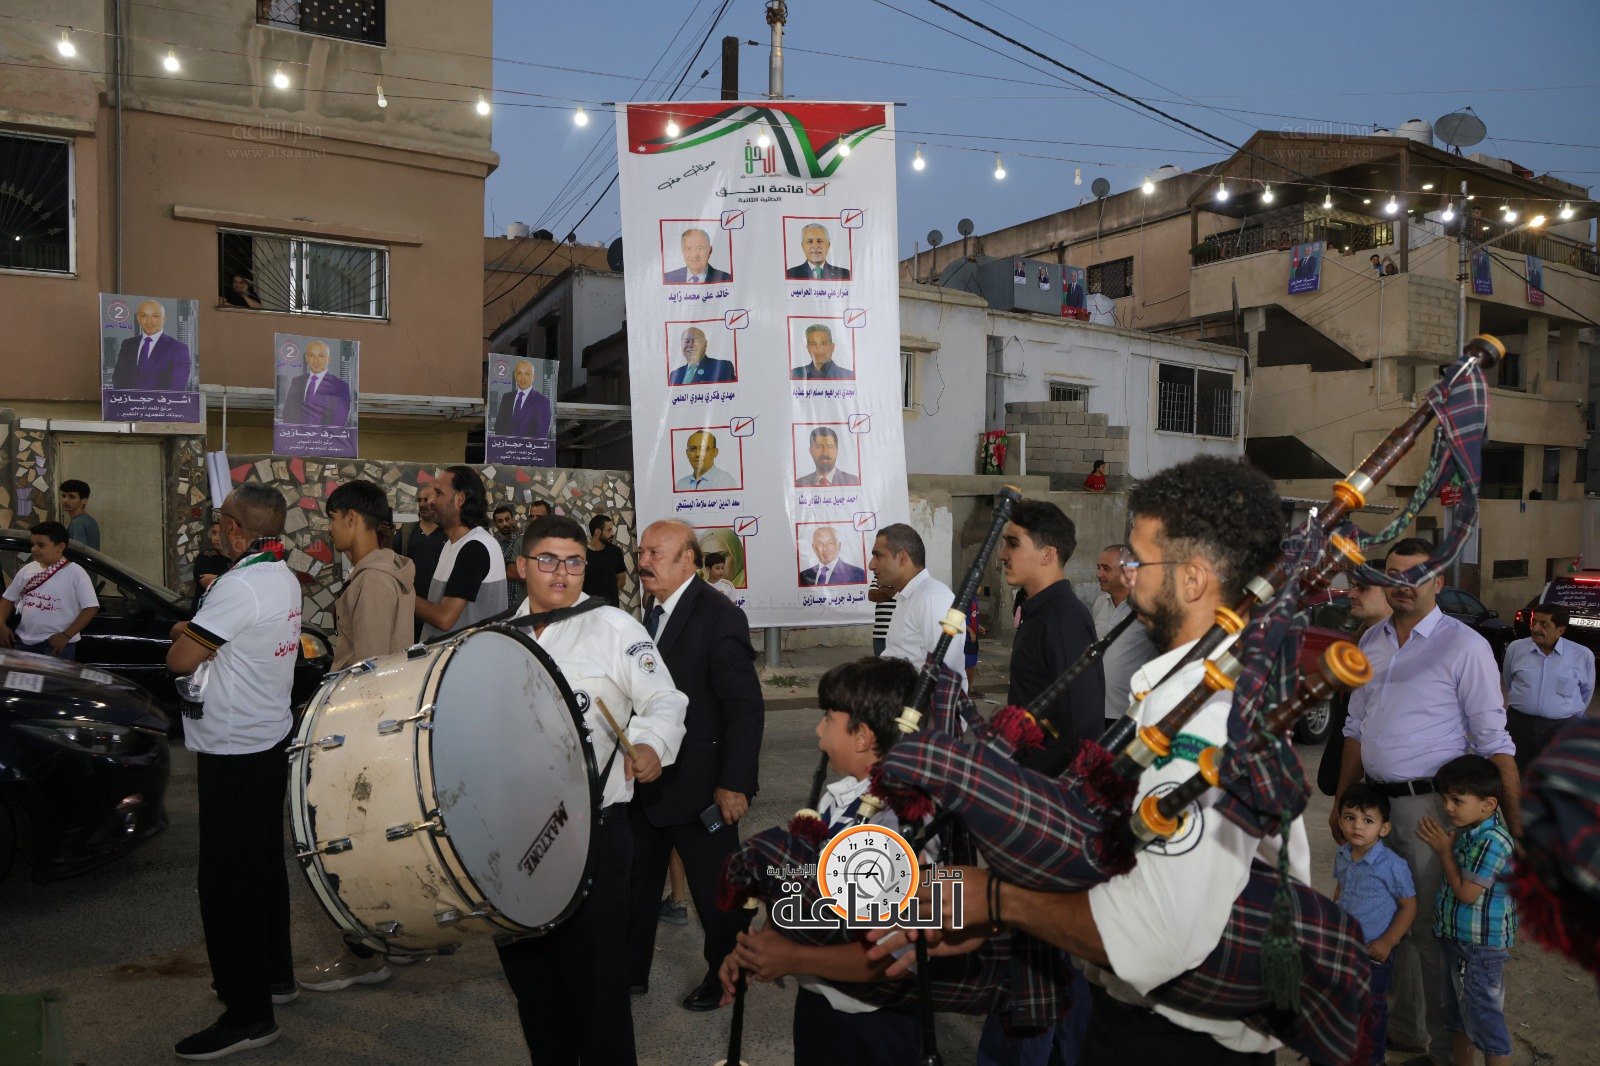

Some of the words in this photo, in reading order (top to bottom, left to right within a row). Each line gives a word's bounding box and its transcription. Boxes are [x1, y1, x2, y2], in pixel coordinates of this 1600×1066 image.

[769, 184, 804, 194] قائمة
[668, 290, 683, 303] زايد
[683, 293, 700, 301] محمد
[701, 291, 714, 304] علي
[715, 288, 730, 299] خالد
[114, 306, 124, 319] 2
[286, 346, 295, 358] 2
[498, 365, 506, 376] 2
[109, 394, 155, 405] حجازين
[671, 393, 689, 406] العلمي
[689, 393, 704, 404] بدوي
[704, 390, 720, 404] فكري
[720, 391, 736, 403] مهدي
[279, 428, 318, 439] حجازين
[491, 439, 524, 449] حجازين
[695, 498, 707, 509] سلامة
[718, 498, 731, 510] الدين
[802, 595, 828, 607] حجازين
[523, 800, 569, 877] MAXTONE
